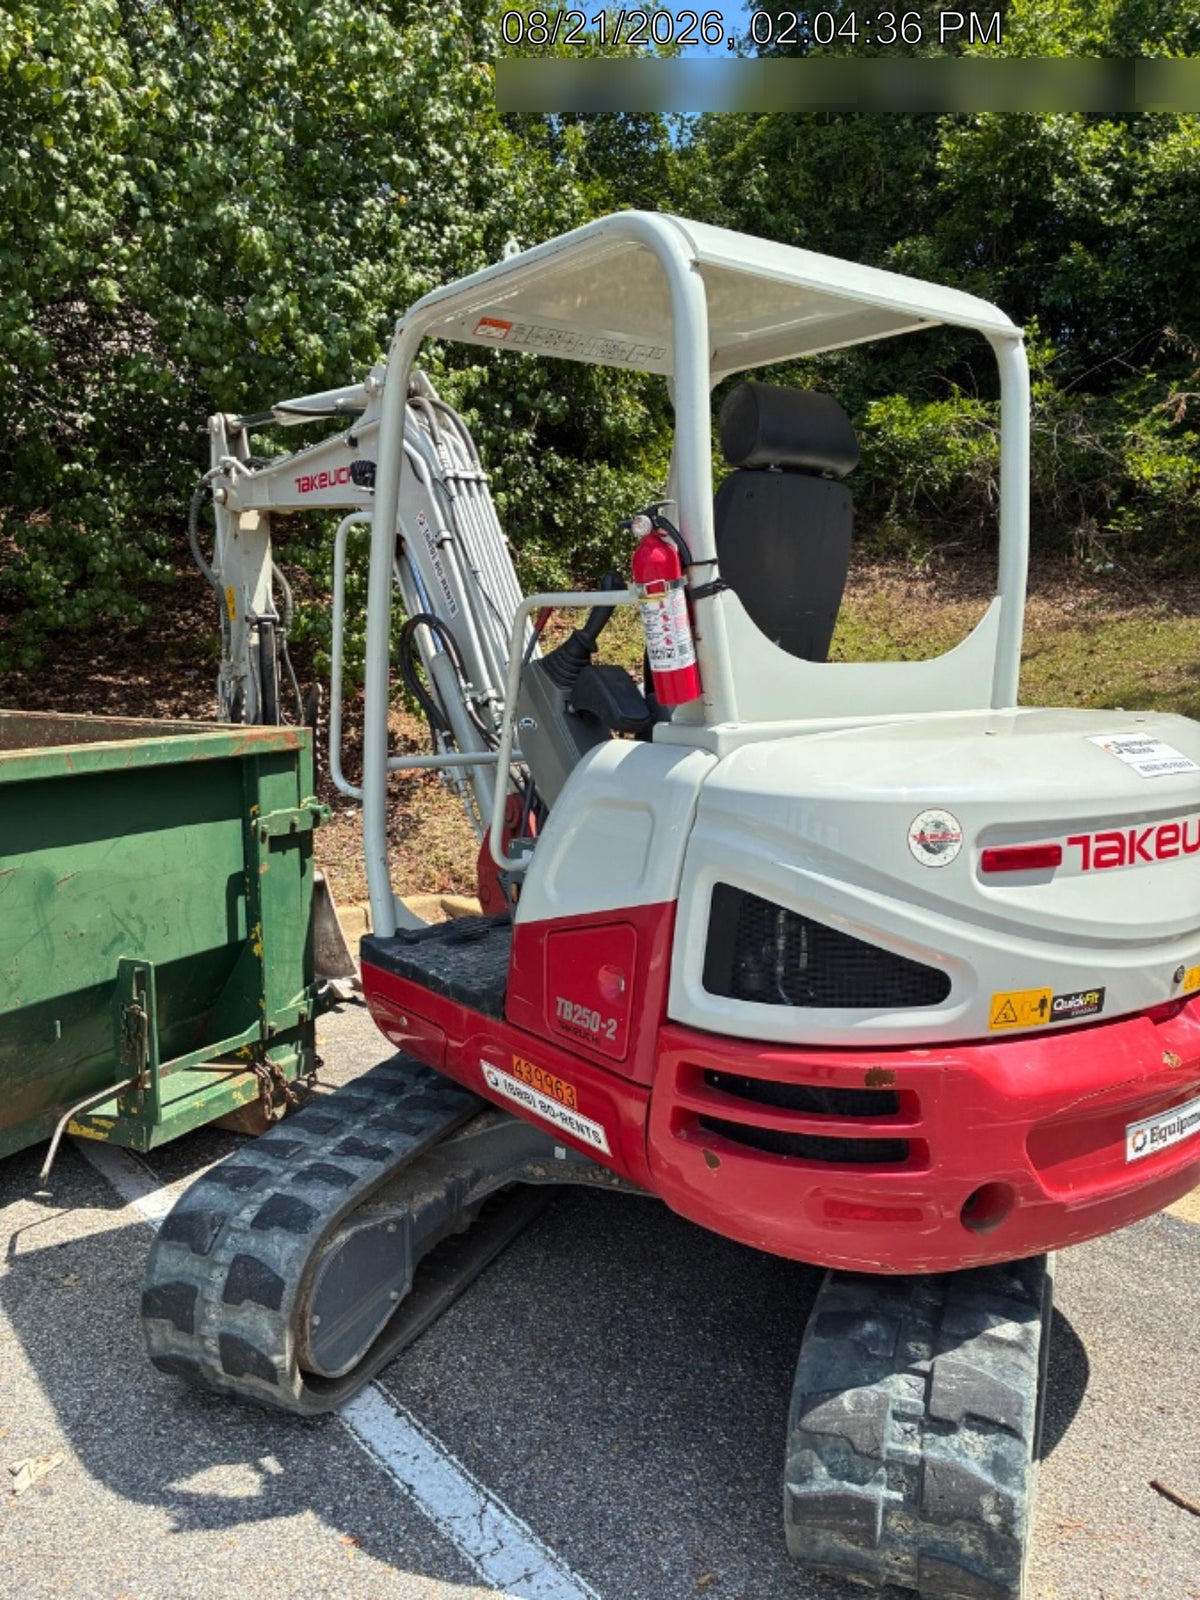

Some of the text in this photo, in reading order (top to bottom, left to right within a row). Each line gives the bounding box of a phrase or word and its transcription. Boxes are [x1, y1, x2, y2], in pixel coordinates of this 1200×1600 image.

[556, 996, 617, 1041] TB250-2
[515, 1059, 575, 1108] 439963
[503, 1079, 602, 1144] (888) 80-RENTS
